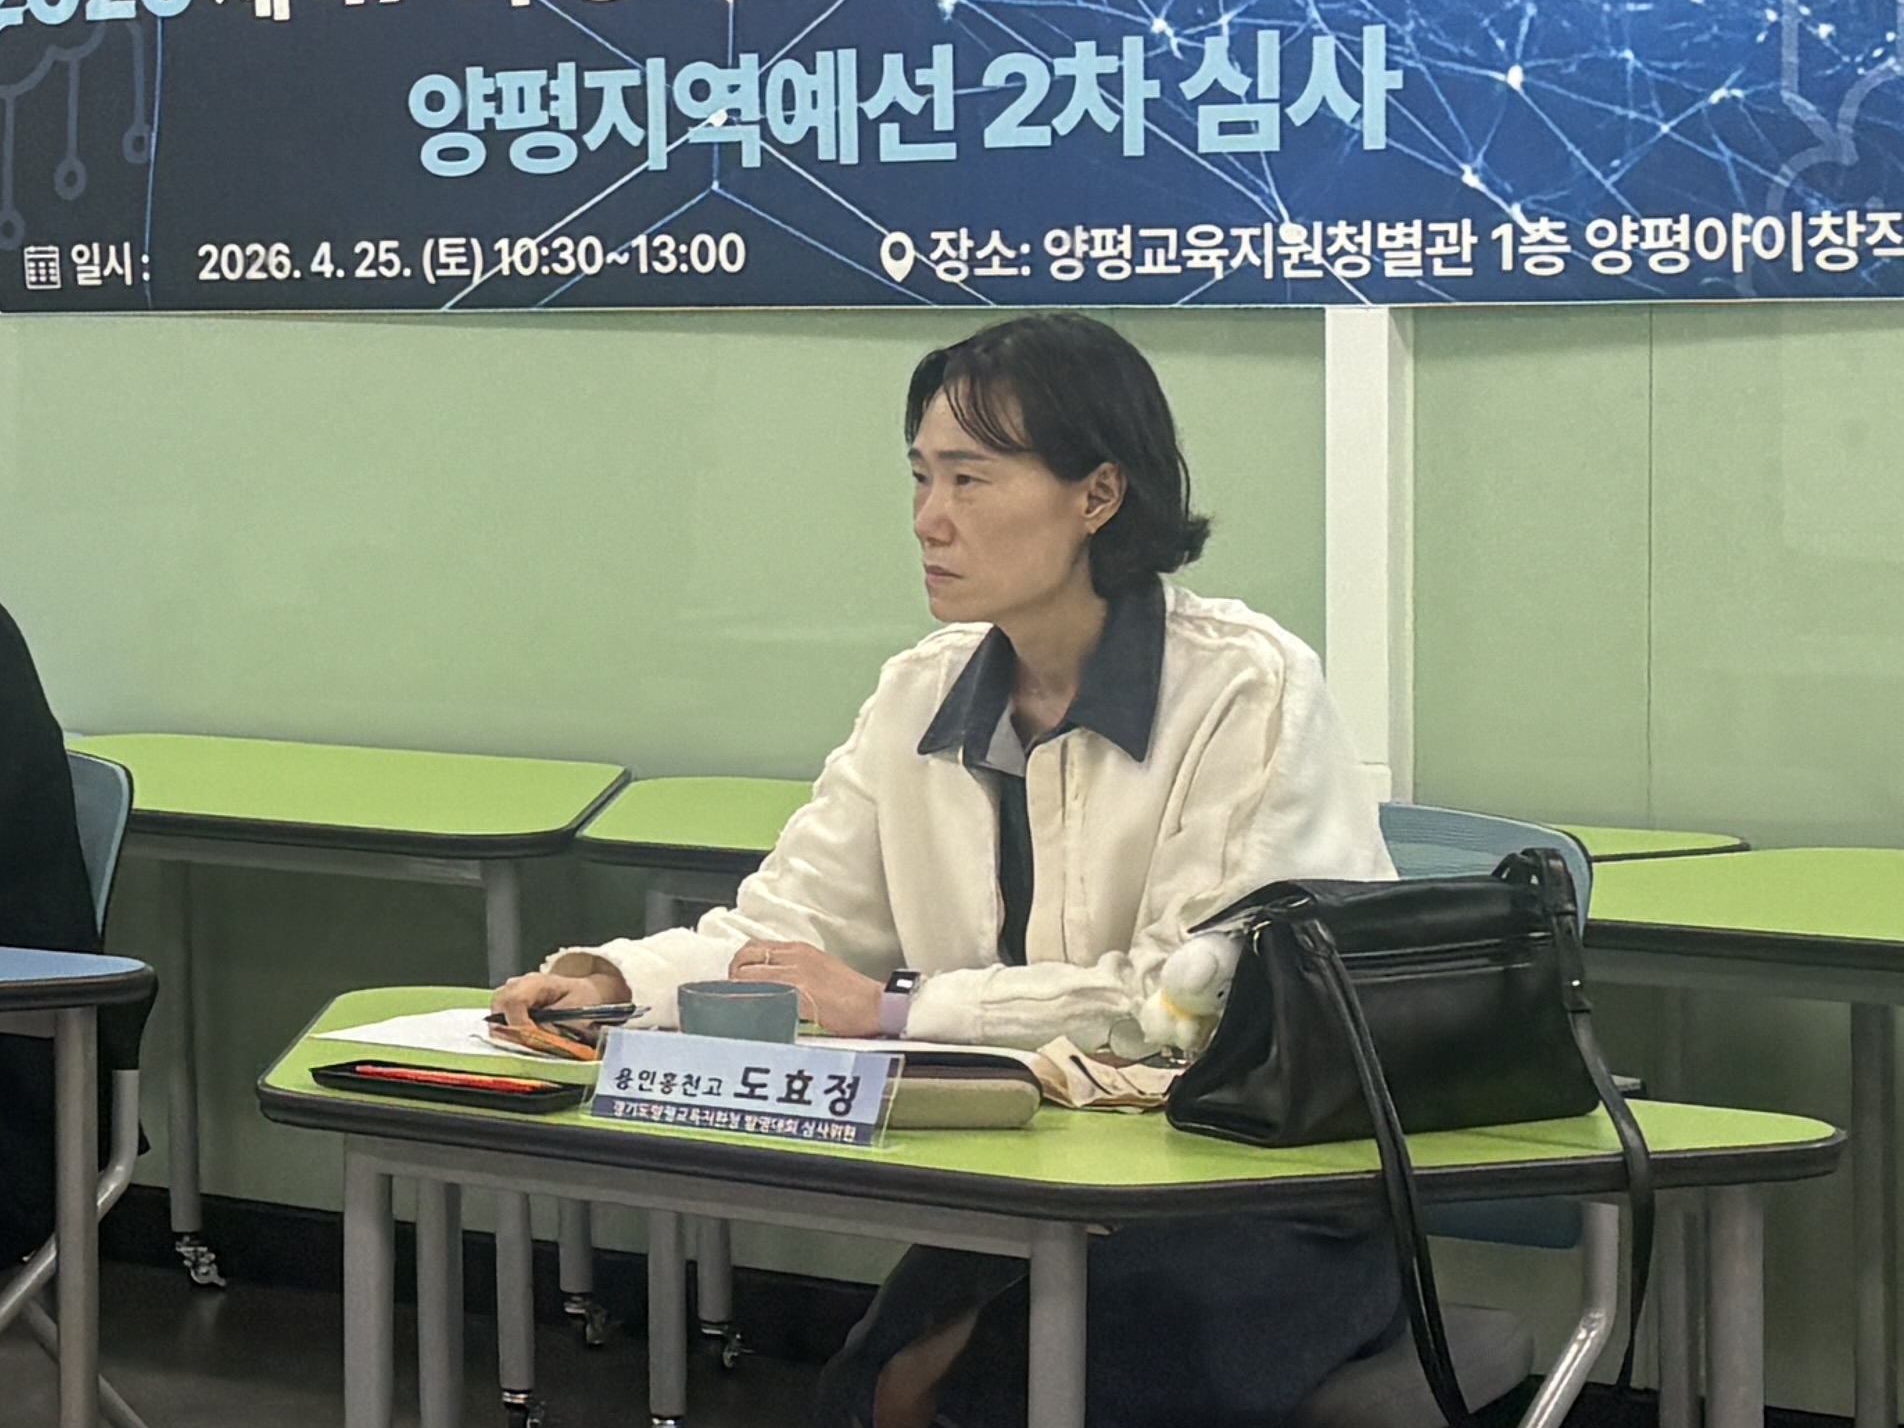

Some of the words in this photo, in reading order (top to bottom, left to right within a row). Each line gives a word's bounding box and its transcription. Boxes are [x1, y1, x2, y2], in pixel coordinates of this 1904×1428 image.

[408, 43, 958, 177] 양평지역예선
[981, 35, 1161, 157] 2차
[1178, 23, 1404, 153] 심사
[197, 242, 301, 281] 2026.
[310, 241, 345, 279] 4.
[353, 239, 411, 279] 25.
[422, 235, 485, 285] (토)
[494, 232, 746, 276] 10:30~13:00
[929, 228, 1032, 282] 장소:
[1043, 218, 1478, 282] 양평교육지원청별관
[1491, 215, 1571, 275] 1층
[732, 1064, 862, 1117] 도효정
